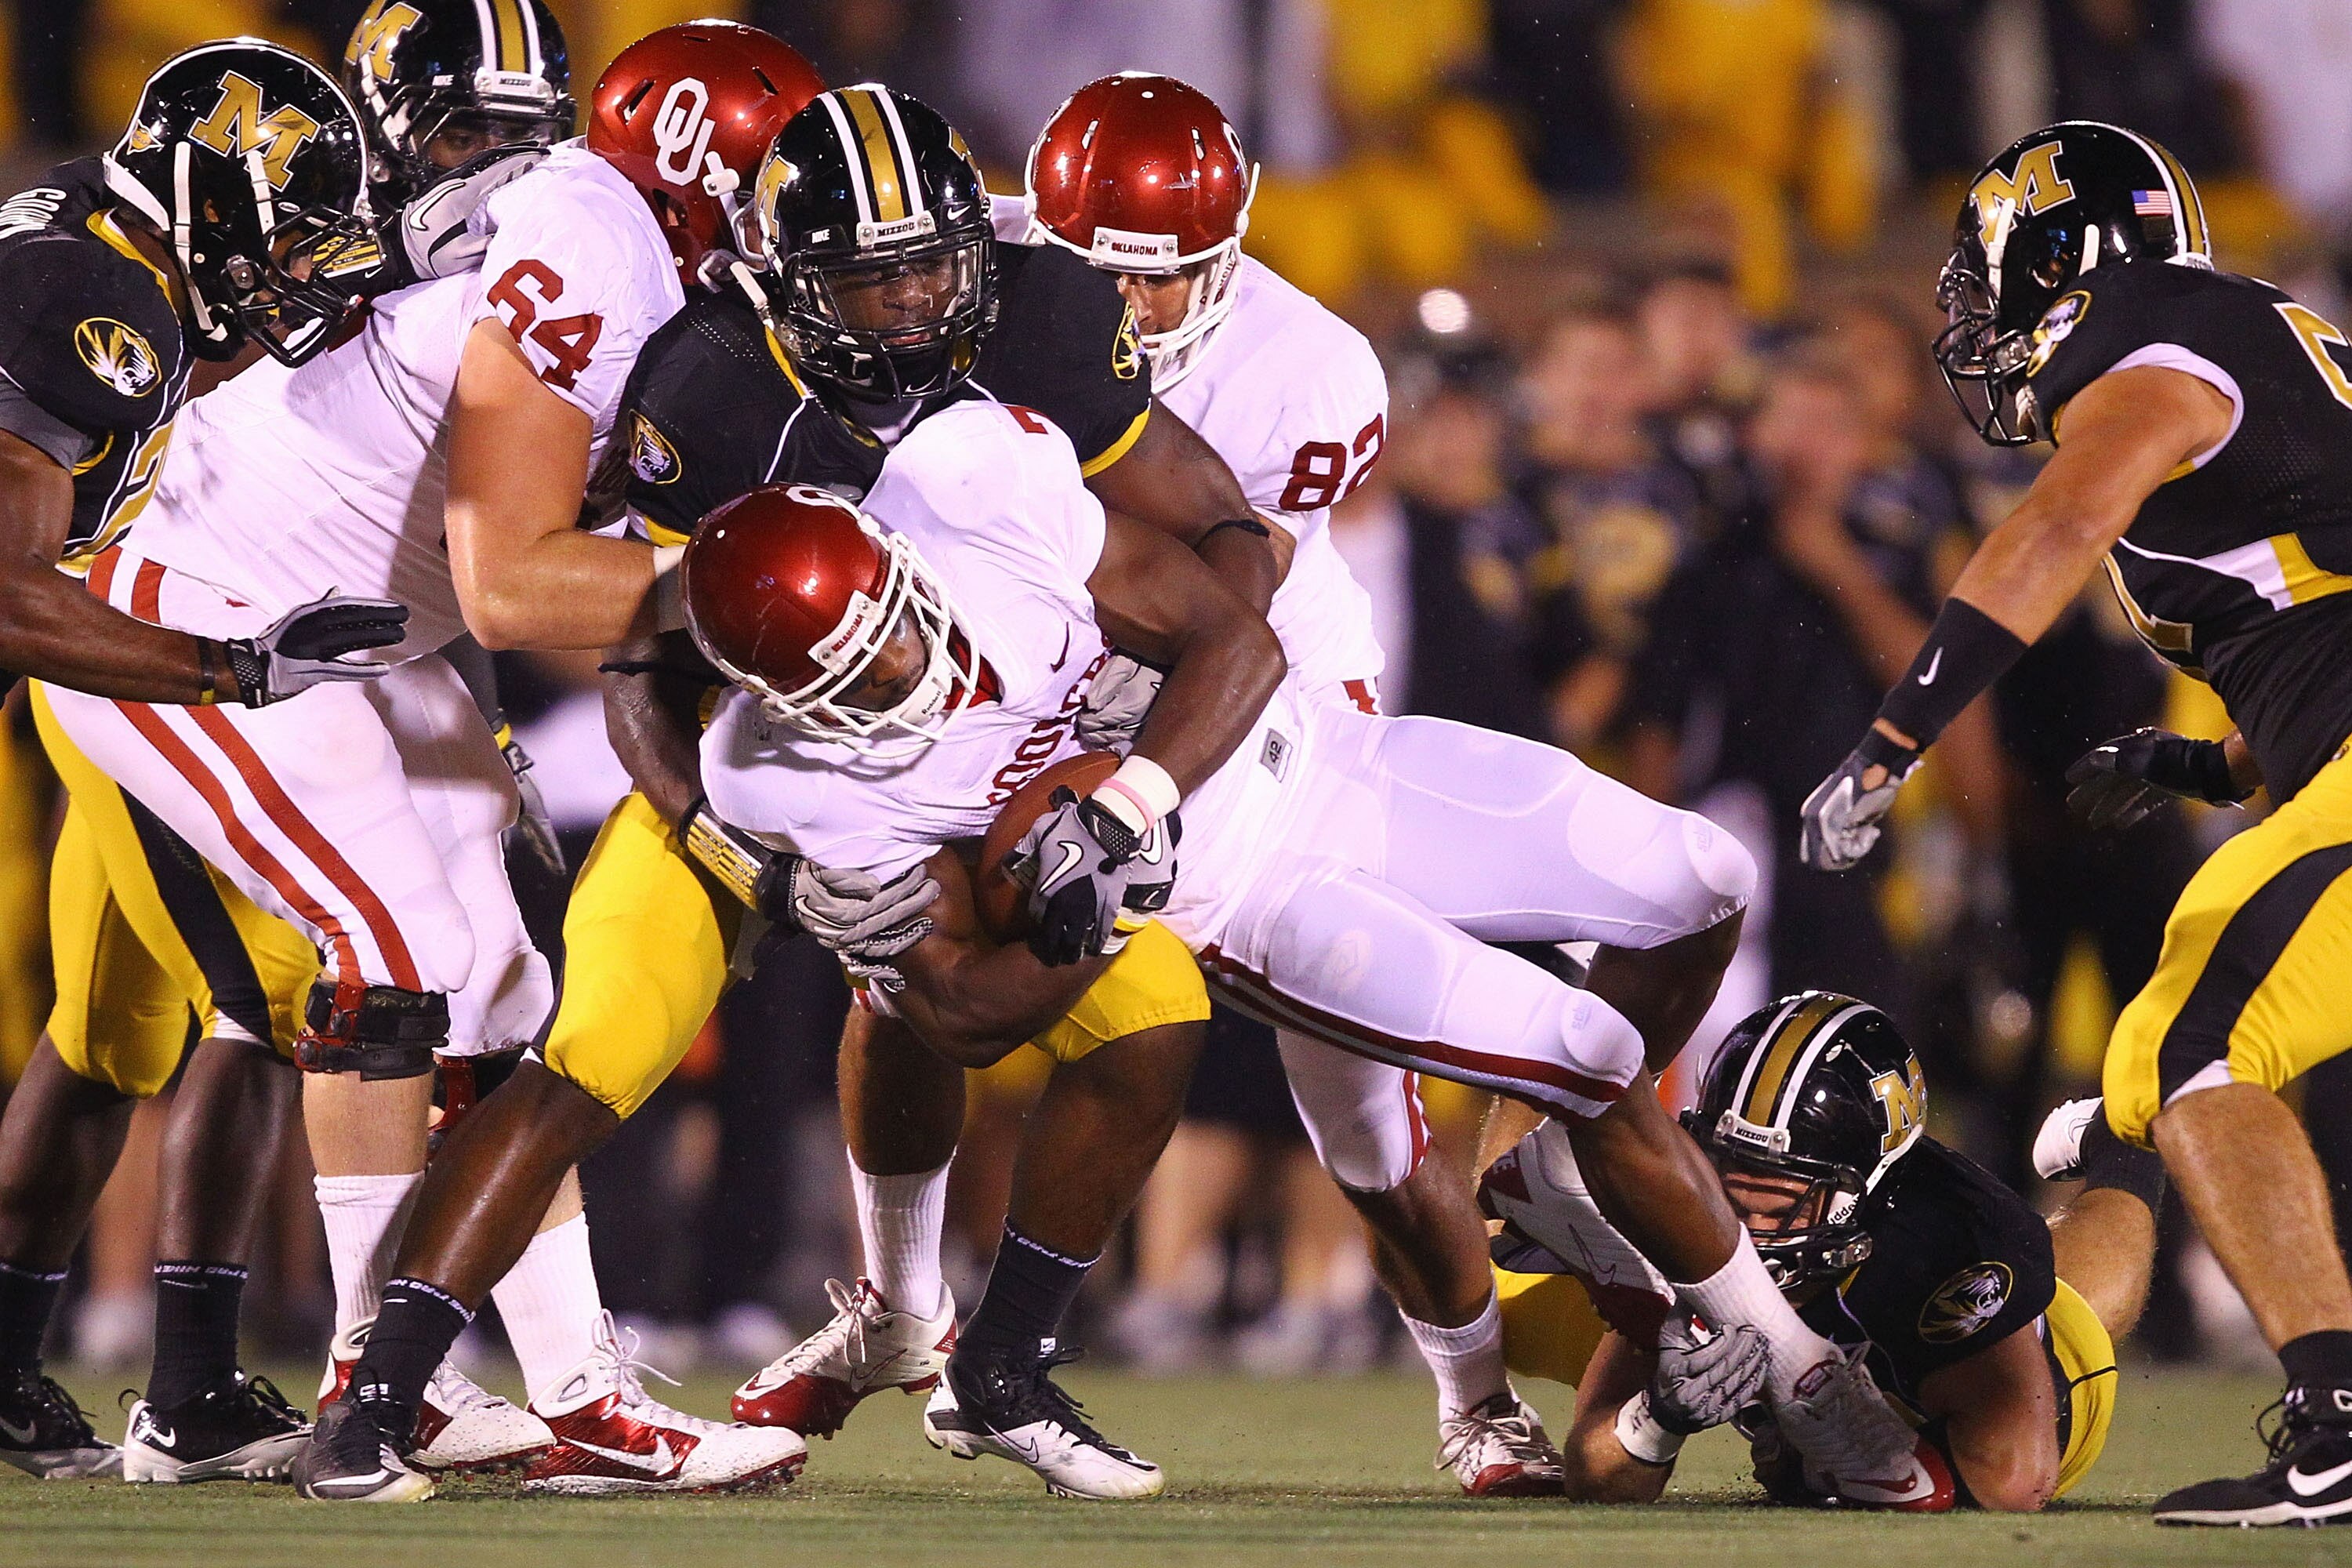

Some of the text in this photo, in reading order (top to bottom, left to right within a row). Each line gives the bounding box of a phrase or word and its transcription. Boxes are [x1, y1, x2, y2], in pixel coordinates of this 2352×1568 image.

[188, 70, 321, 192] M
[877, 222, 916, 237] MIZZOU
[1972, 140, 2075, 249] M
[1111, 241, 1159, 256] OKLAHOMA
[488, 260, 603, 390] 64
[1278, 412, 1385, 512] 82
[1735, 1127, 1769, 1143] MIZZOU
